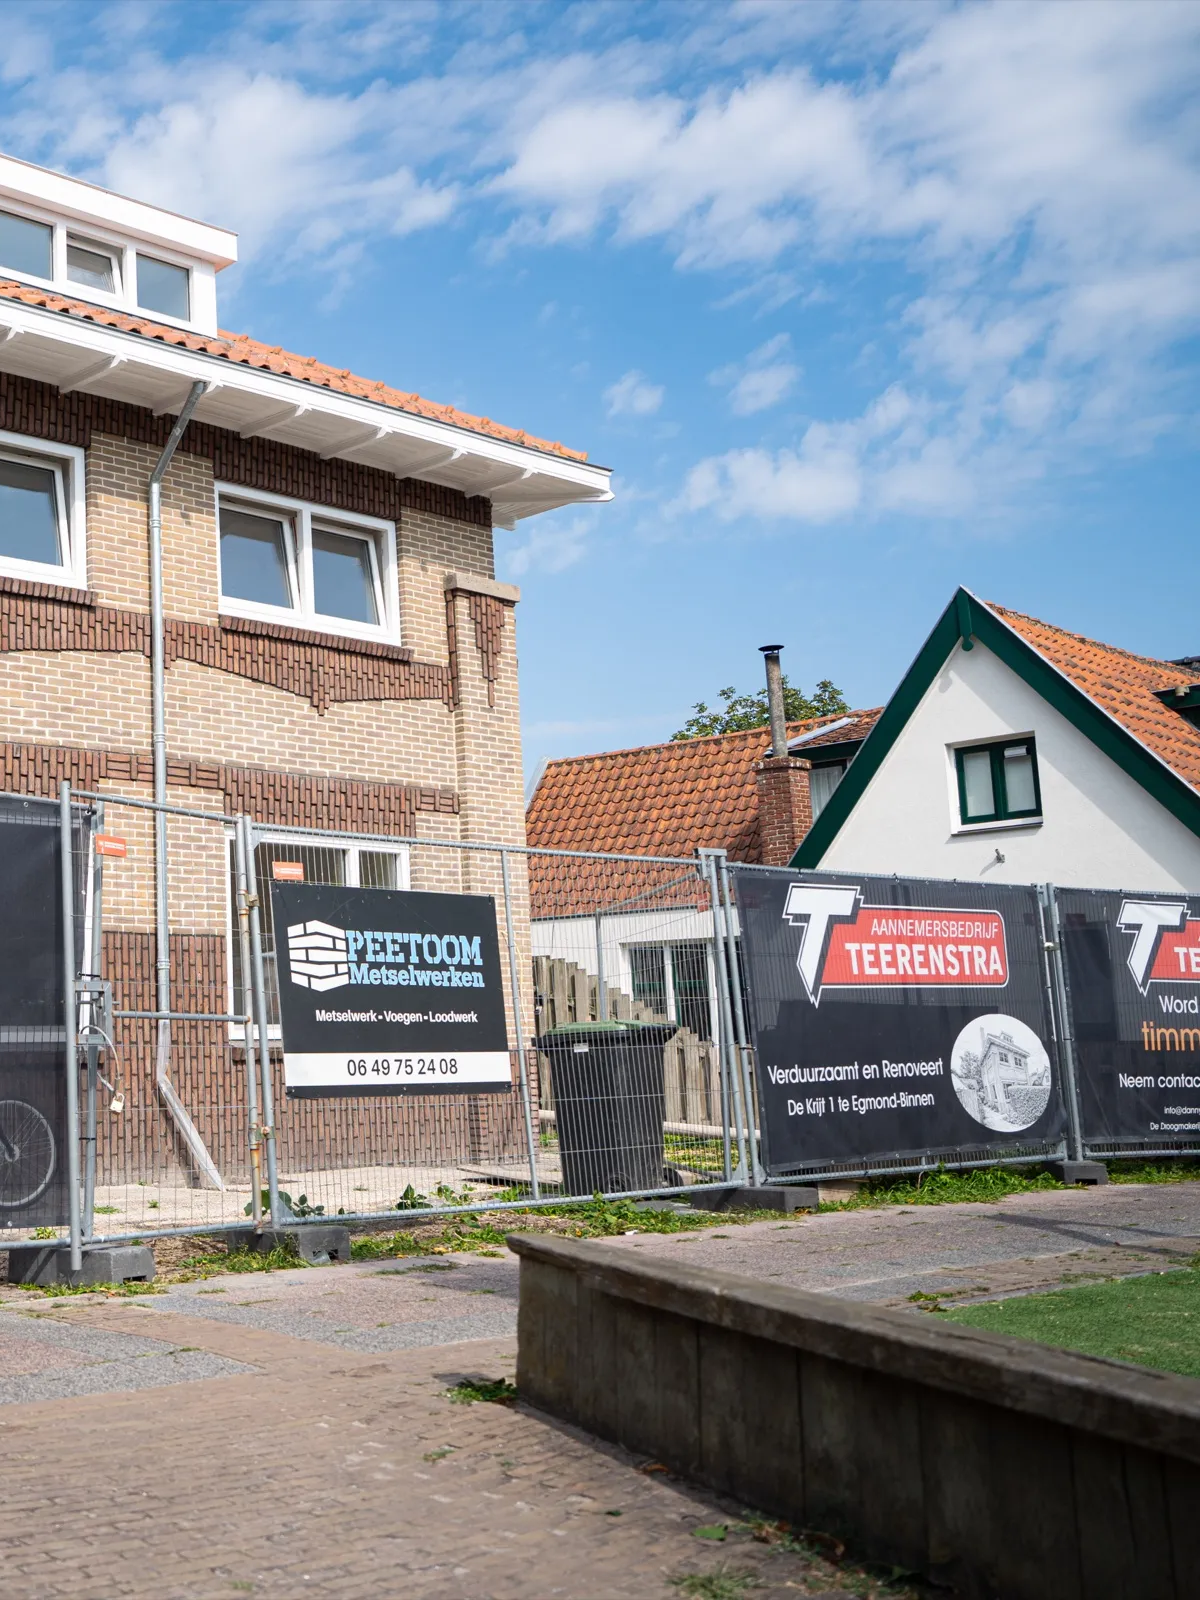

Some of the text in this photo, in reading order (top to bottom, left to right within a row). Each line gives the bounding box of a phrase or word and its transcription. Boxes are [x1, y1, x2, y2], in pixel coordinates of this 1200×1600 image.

[870, 919, 998, 939] AANNEMERSBEDRIJF
[345, 930, 483, 965] PEETOOM
[845, 942, 1003, 976] TEERENSTRA
[348, 963, 485, 988] Metselwerken
[1159, 995, 1198, 1013] Word
[347, 1058, 458, 1076] 06 49 75 24 08
[767, 1058, 943, 1084] Verduurzaamt en Renoveert
[1119, 1073, 1154, 1088] Neem
[787, 1092, 934, 1117] De Krijt 1 te Egmond-Binnen
[1150, 1122, 1160, 1131] De
